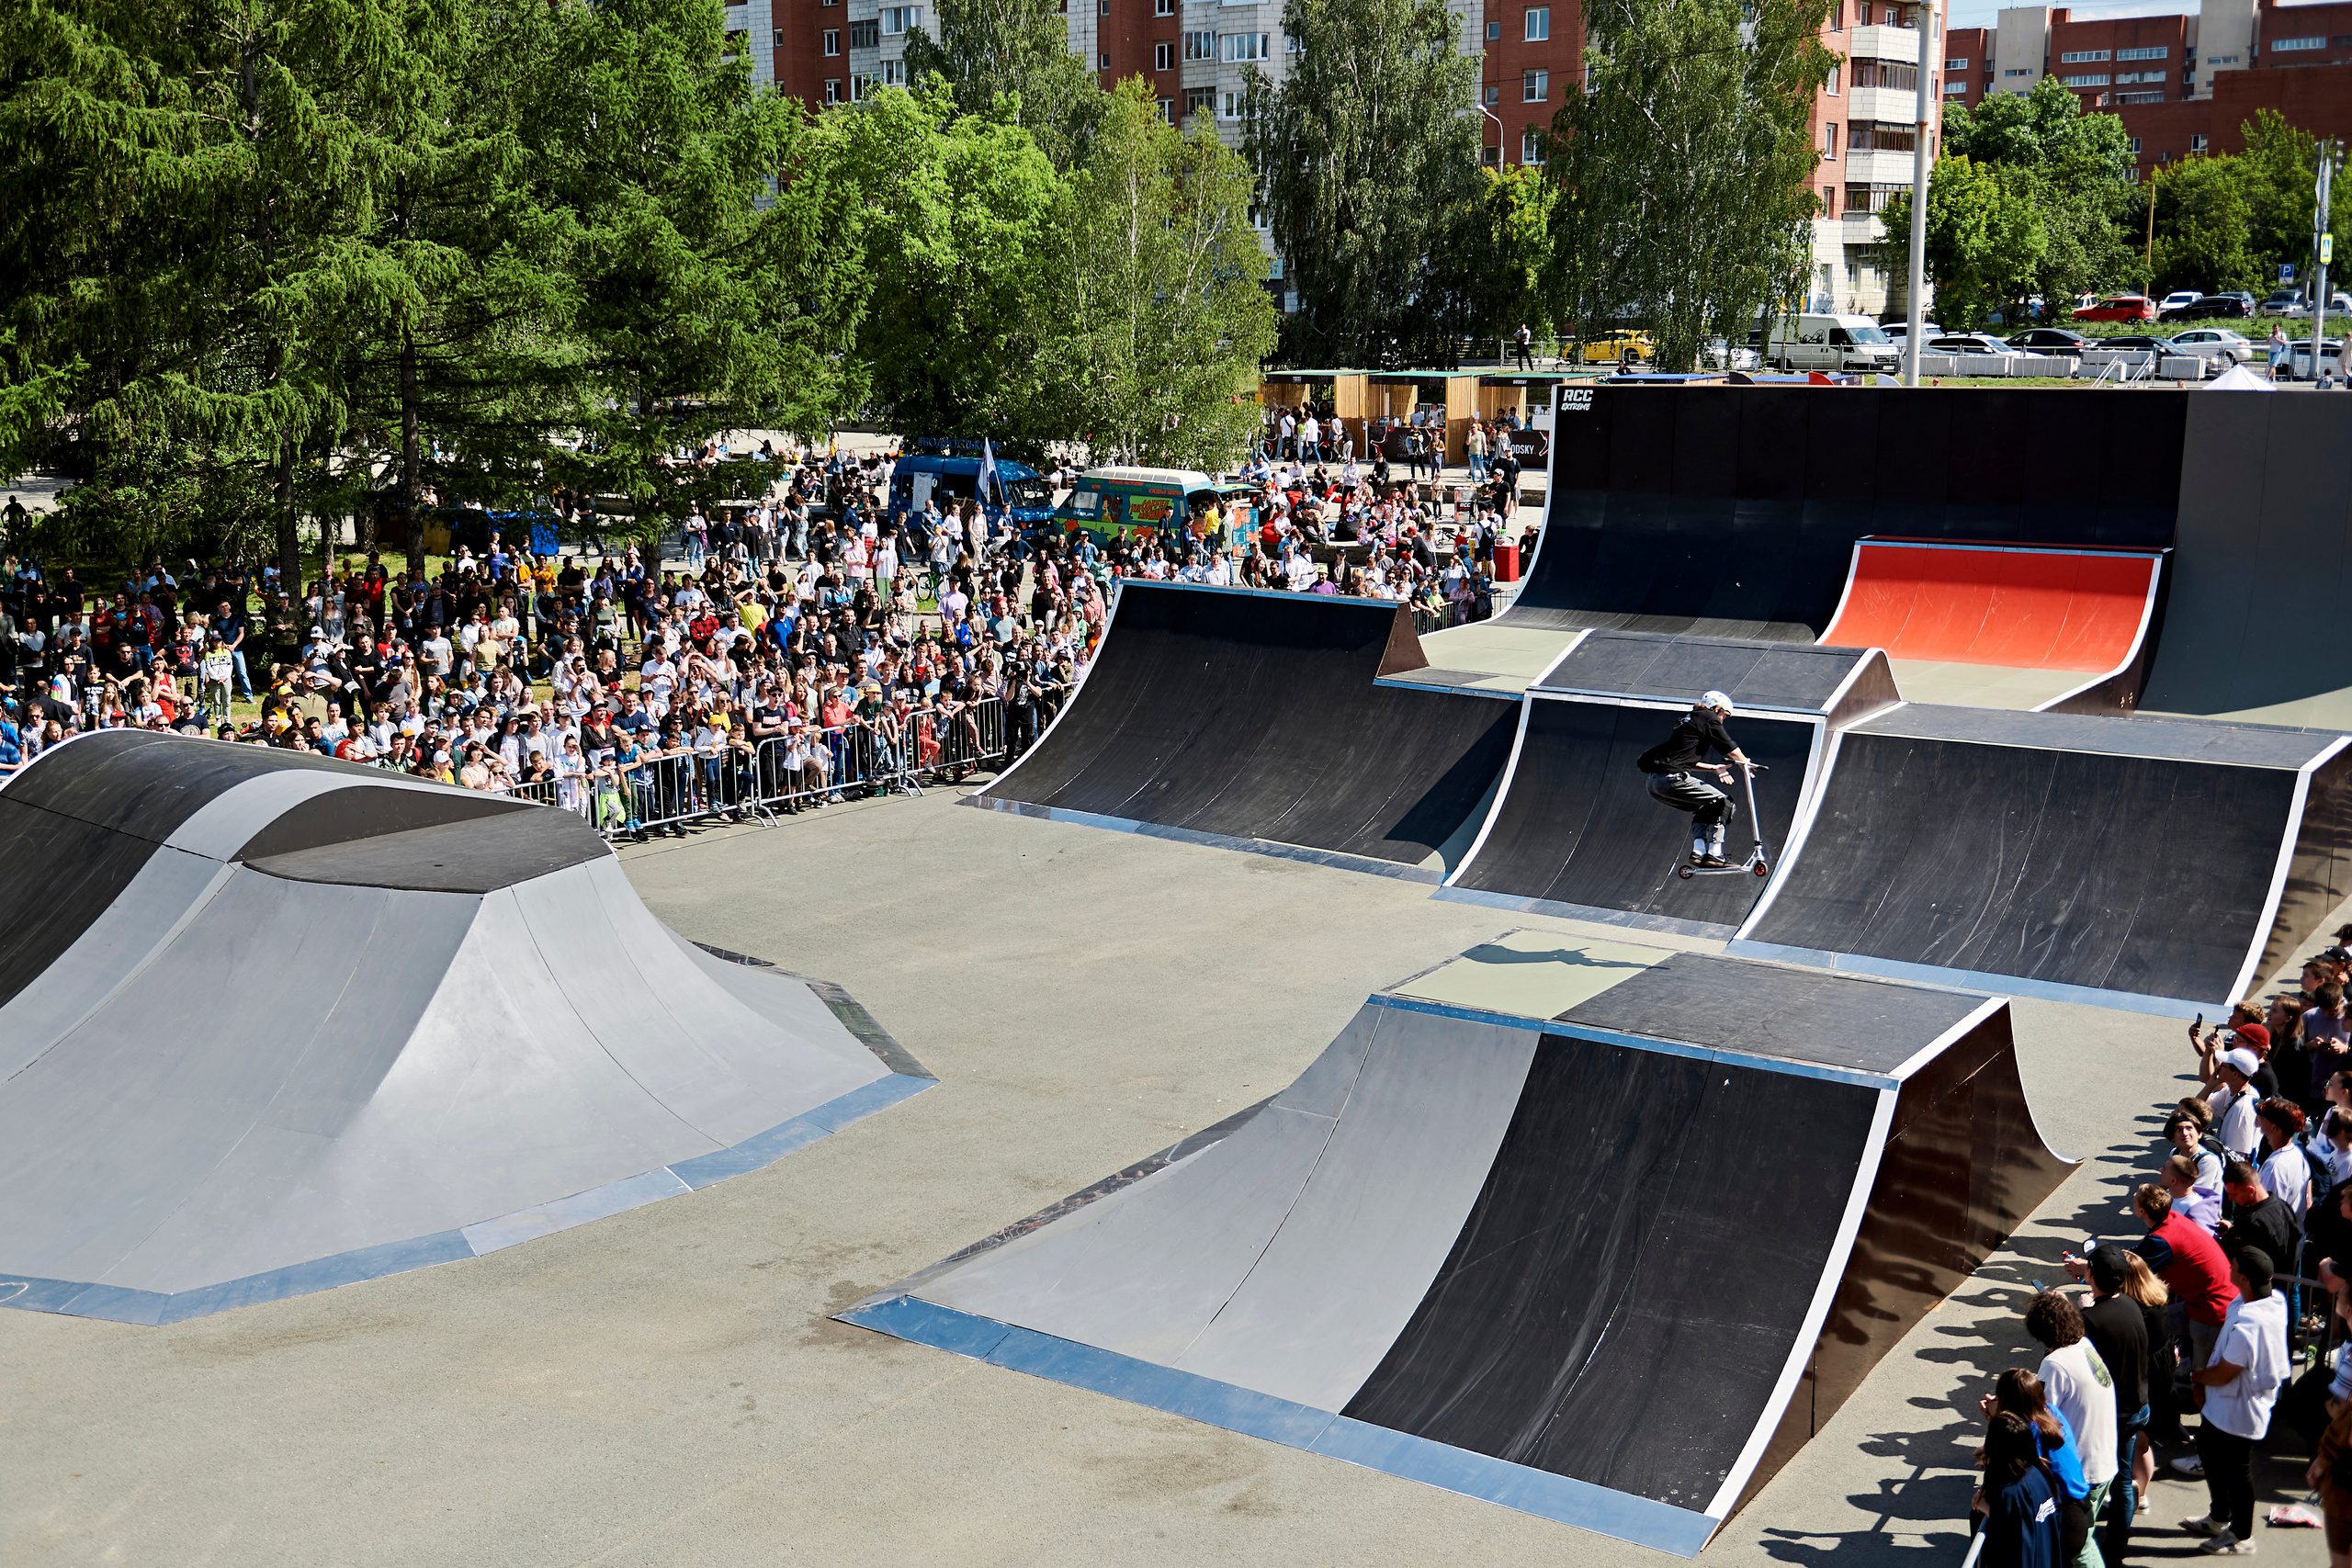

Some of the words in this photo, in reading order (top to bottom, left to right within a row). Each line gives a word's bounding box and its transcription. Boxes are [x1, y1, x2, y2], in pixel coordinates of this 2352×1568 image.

[2283, 266, 2291, 276] P
[1563, 389, 1594, 402] RCC
[1561, 402, 1591, 412] EXTREME
[1510, 444, 1537, 455] ODSKY.
[1141, 499, 1170, 513] COFFEE
[1137, 508, 1166, 521] MACHIN
